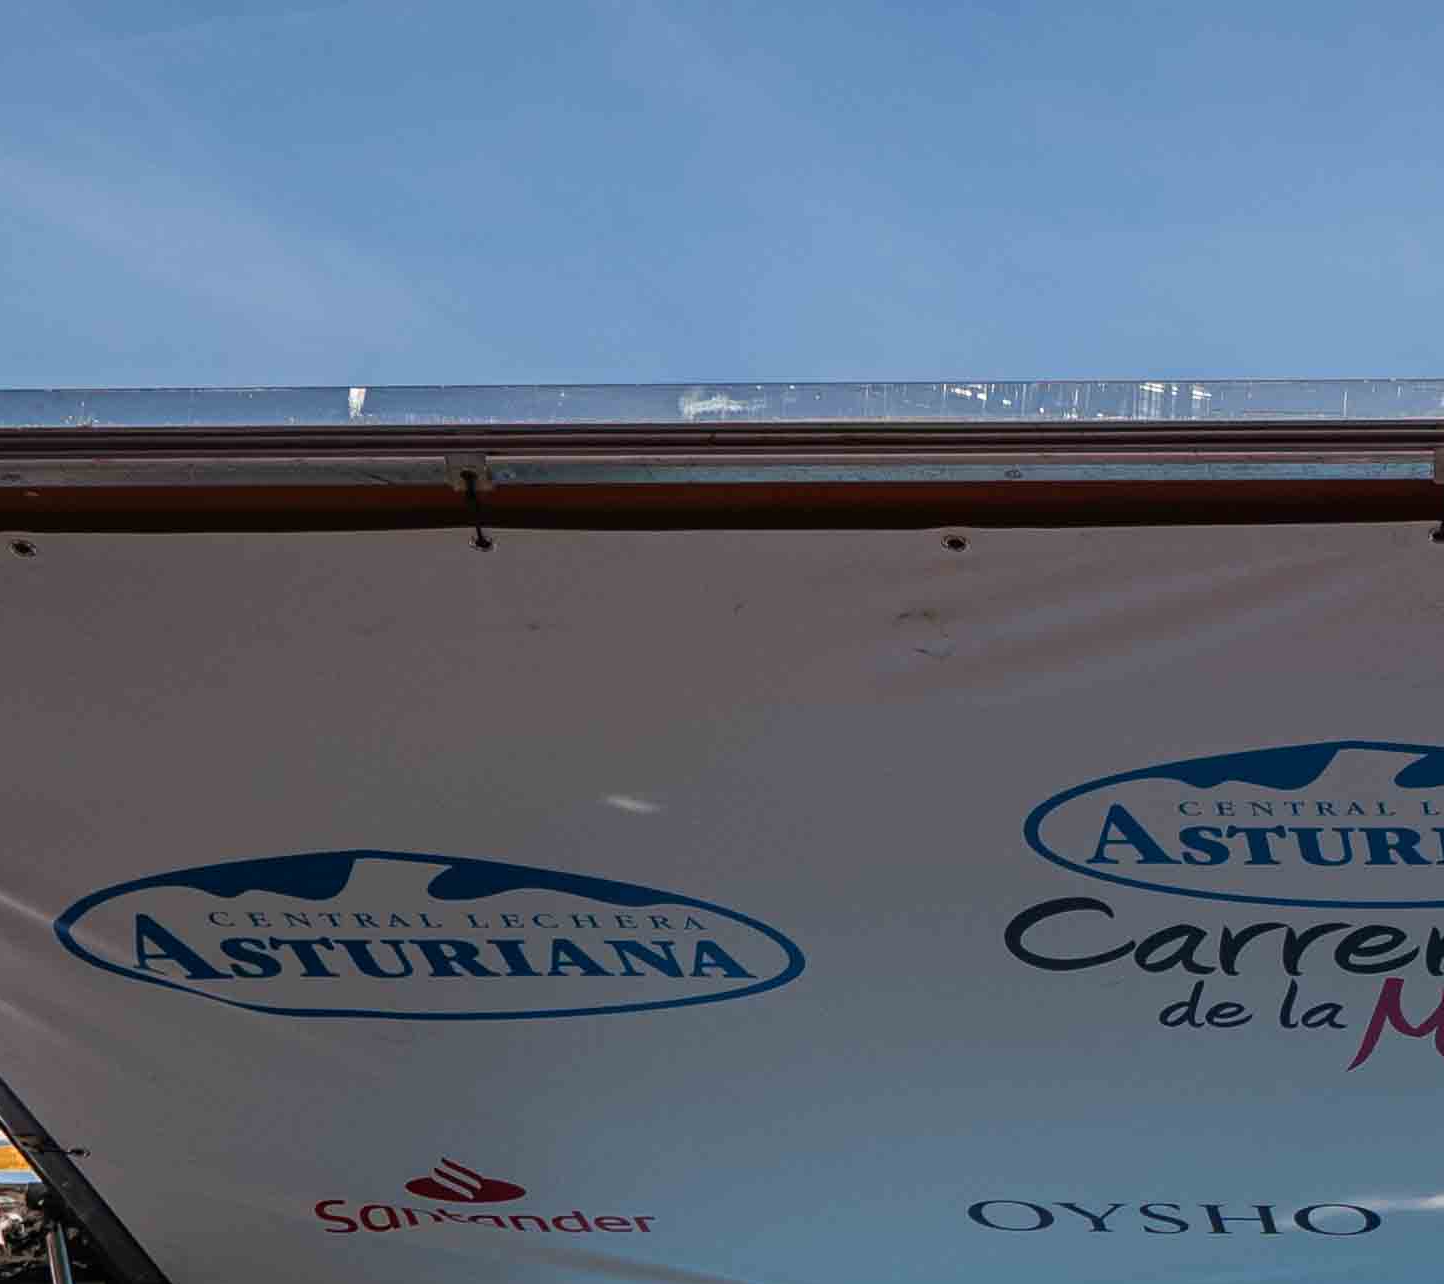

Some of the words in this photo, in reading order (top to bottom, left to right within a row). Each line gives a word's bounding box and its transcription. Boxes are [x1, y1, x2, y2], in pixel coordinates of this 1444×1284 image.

[1178, 800, 1395, 817] CENTRAL
[208, 910, 443, 930] CENTRAL
[466, 912, 708, 931] LECHERA
[132, 912, 757, 981] ASTURIANA
[1159, 981, 1251, 1029] de
[1280, 980, 1346, 1030] la
[314, 1200, 657, 1235] Santander
[967, 1199, 1382, 1236] OYSHO
